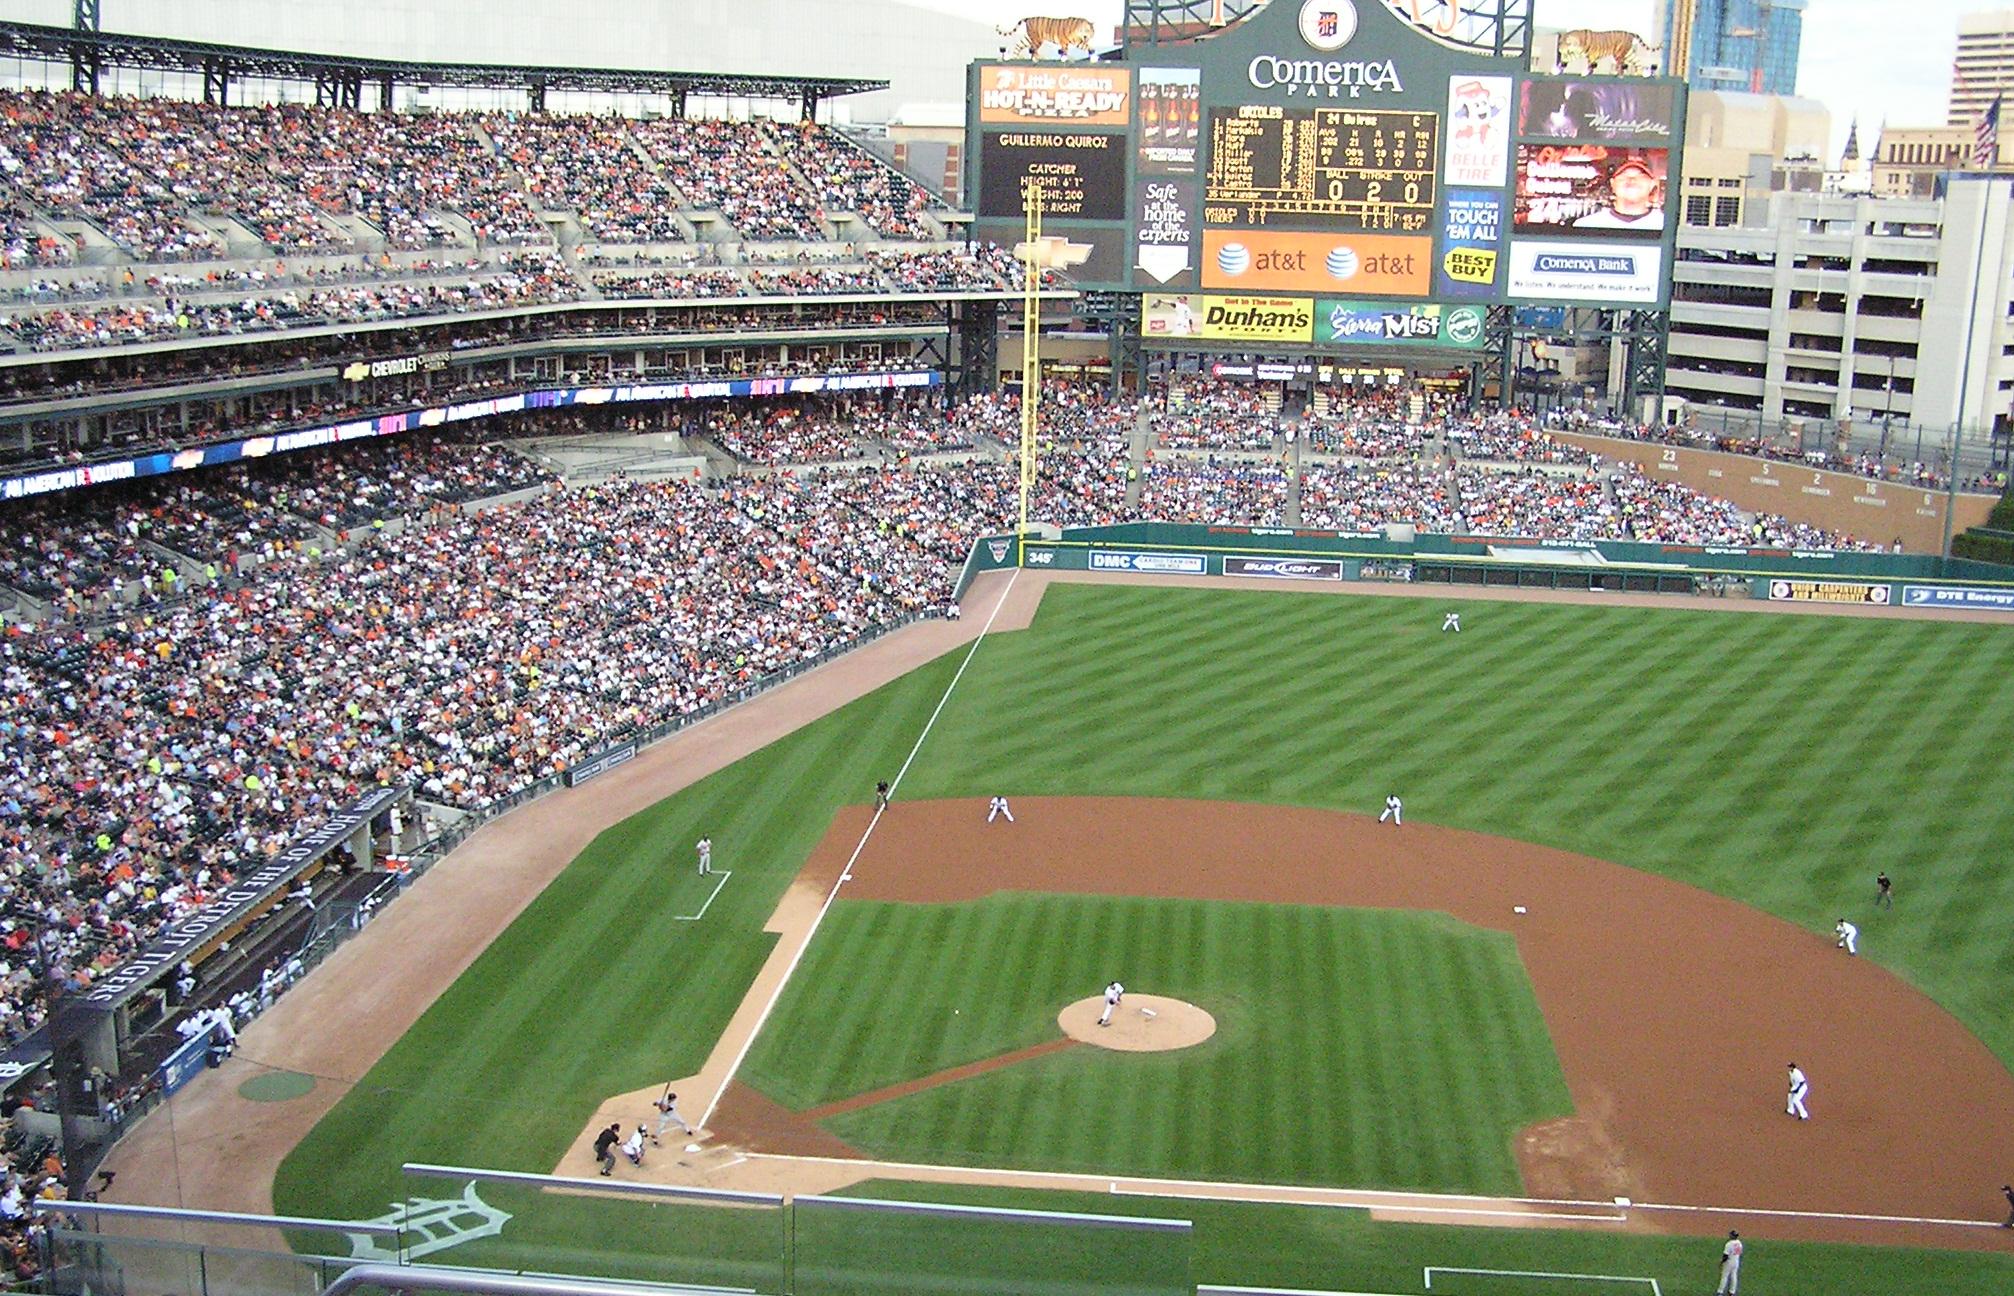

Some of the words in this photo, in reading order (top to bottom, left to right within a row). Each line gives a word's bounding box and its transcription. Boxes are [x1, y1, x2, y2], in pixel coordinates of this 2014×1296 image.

[1019, 73, 1055, 89] Little
[1058, 74, 1113, 92] Caesars
[1287, 84, 1360, 98] PARK
[983, 90, 1127, 111] HOT-N-READY
[1239, 105, 1283, 119] ORIOLES
[1327, 113, 1340, 125] 24
[999, 134, 1064, 147] GUILLERMO
[1065, 135, 1108, 148] QUIROZ
[1452, 152, 1499, 166] BELLE
[1028, 164, 1077, 175] CATCHER
[1326, 170, 1349, 180] BALL
[1359, 171, 1393, 181] STRIKE
[1403, 172, 1423, 182] OUT
[1457, 168, 1492, 181] TIRE
[1020, 189, 1063, 200] WGHT:
[1064, 190, 1084, 200] 200
[1145, 183, 1178, 202] Safe
[1328, 179, 1344, 201] 0
[1367, 181, 1382, 202] 2
[1404, 182, 1419, 204] 0
[1050, 203, 1082, 213] RIGHT
[1151, 202, 1161, 210] at
[1163, 200, 1179, 211] the
[1471, 201, 1484, 209] YOU
[1143, 205, 1187, 222] home
[1448, 208, 1499, 225] TOUCH
[1152, 221, 1163, 230] of
[1164, 221, 1180, 231] the
[1446, 224, 1471, 240] 'EM
[1472, 226, 1497, 241] ALL
[1139, 228, 1190, 244] experts
[1256, 249, 1307, 272] at&t
[1364, 252, 1415, 275] at&t
[1451, 254, 1494, 267] BEST
[1598, 258, 1629, 271] Bank
[1452, 264, 1488, 277] BUY
[1206, 306, 1310, 328] Dunham's
[1381, 314, 1441, 339] Mist
[372, 357, 417, 377] CHEVROLET
[1663, 449, 1676, 461] 23
[1763, 464, 1769, 475] 5
[1813, 473, 1821, 485] 2
[1094, 554, 1131, 568] DMC
[1243, 563, 1274, 572] BUD
[1279, 565, 1321, 574] LIGHT
[1936, 590, 1964, 601] DTE
[1966, 592, 2014, 606] Energy
[303, 814, 362, 845] HOME
[280, 847, 312, 862] OF
[243, 865, 290, 888] THE
[163, 891, 258, 947] DETROIT
[87, 950, 177, 1002] TIGERS
